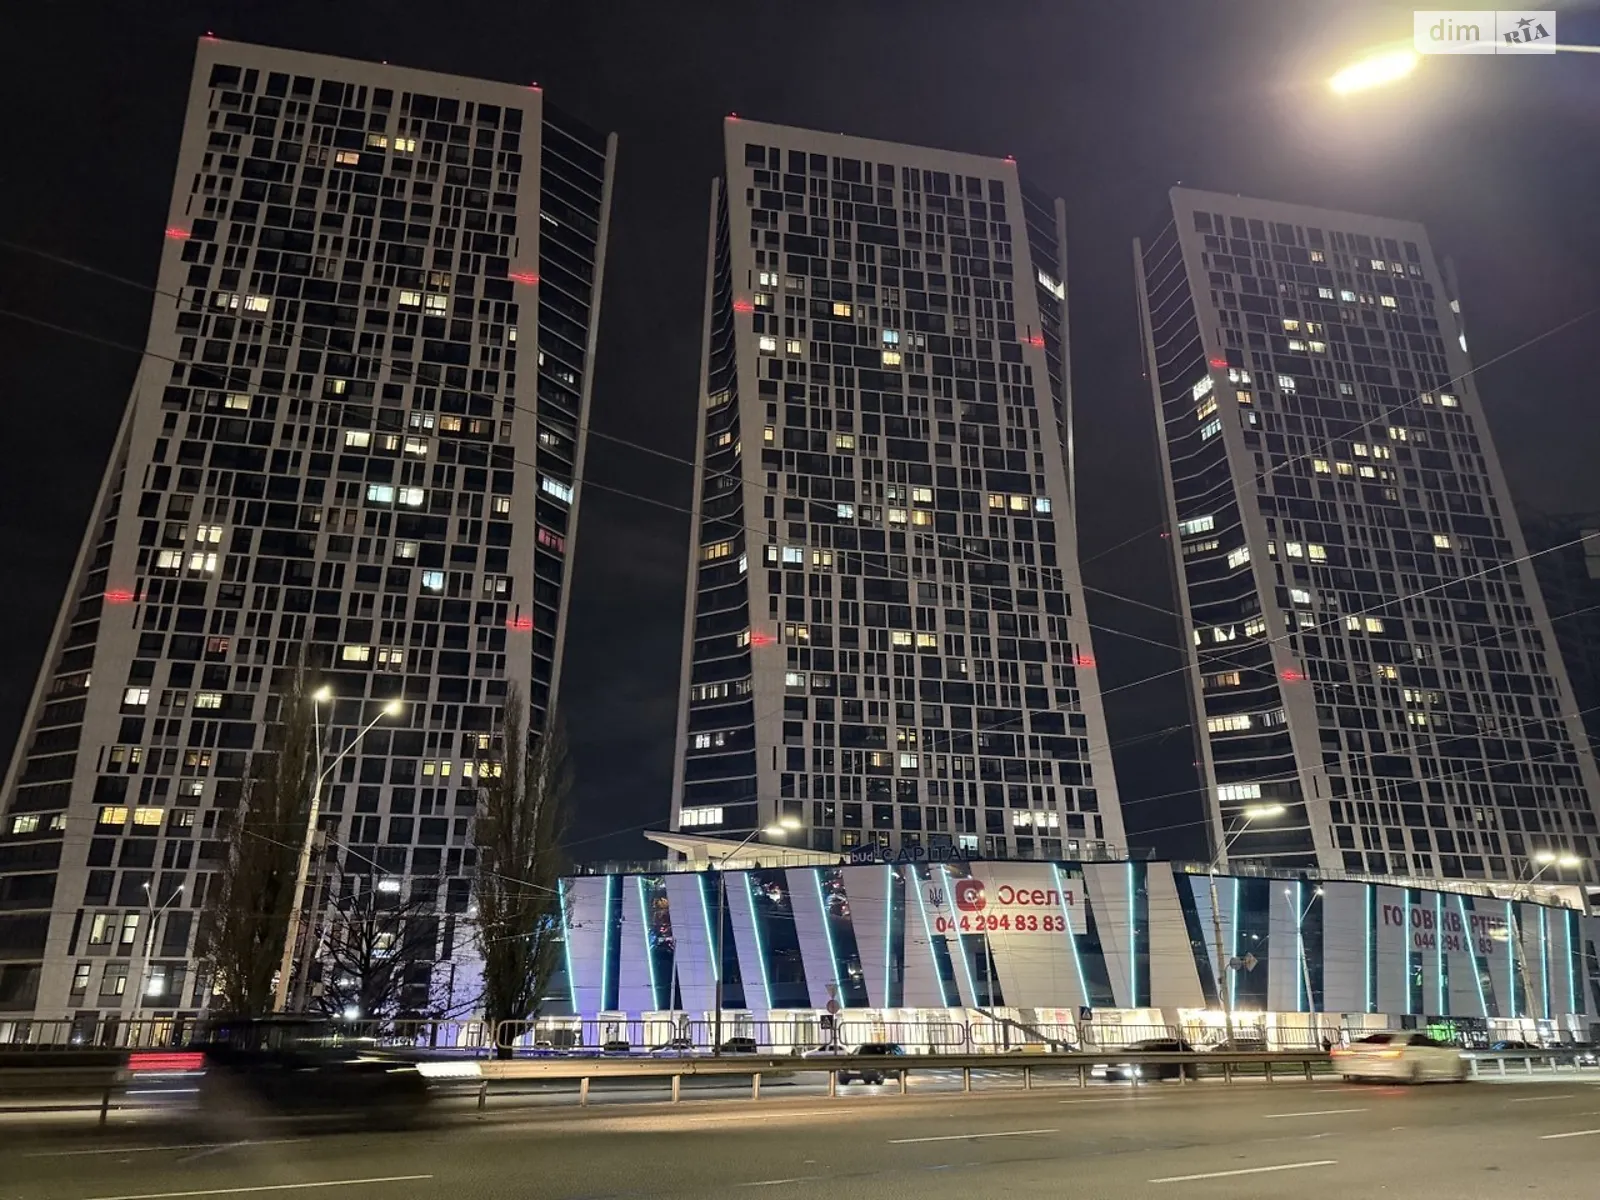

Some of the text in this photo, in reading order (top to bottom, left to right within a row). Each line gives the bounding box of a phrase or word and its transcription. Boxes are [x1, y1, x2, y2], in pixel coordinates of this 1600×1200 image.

[882, 845, 979, 862] CAPITAL
[998, 885, 1075, 906] Оселя
[935, 914, 1067, 933] 044 294 83 83
